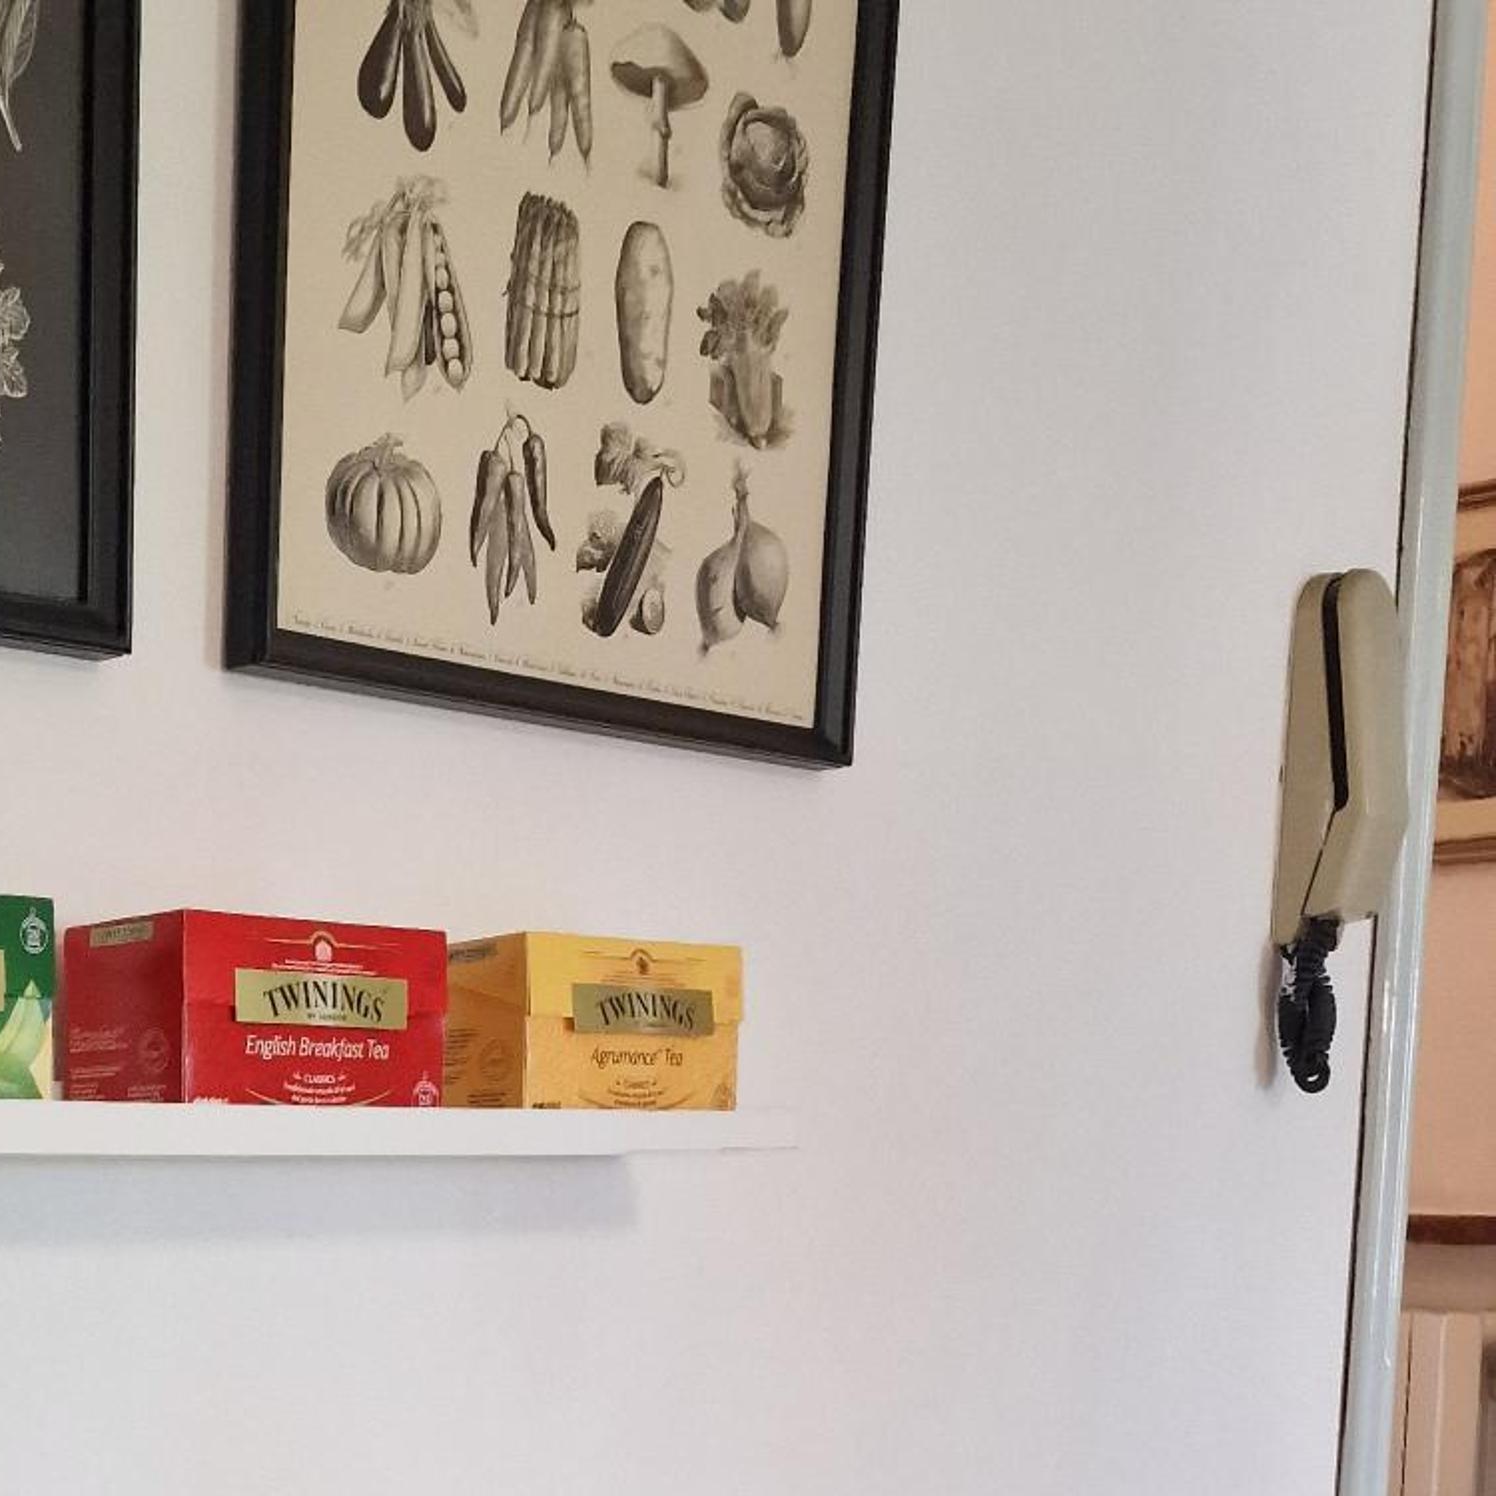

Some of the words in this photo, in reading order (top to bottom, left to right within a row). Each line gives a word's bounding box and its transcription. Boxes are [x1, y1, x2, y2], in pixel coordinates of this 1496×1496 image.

[263, 979, 385, 1023] TWININGS
[596, 990, 696, 1031] TWININGS
[245, 1034, 297, 1061] English
[298, 1036, 364, 1062] Breakfast
[366, 1038, 390, 1060] Tea
[664, 1047, 683, 1067] Tea
